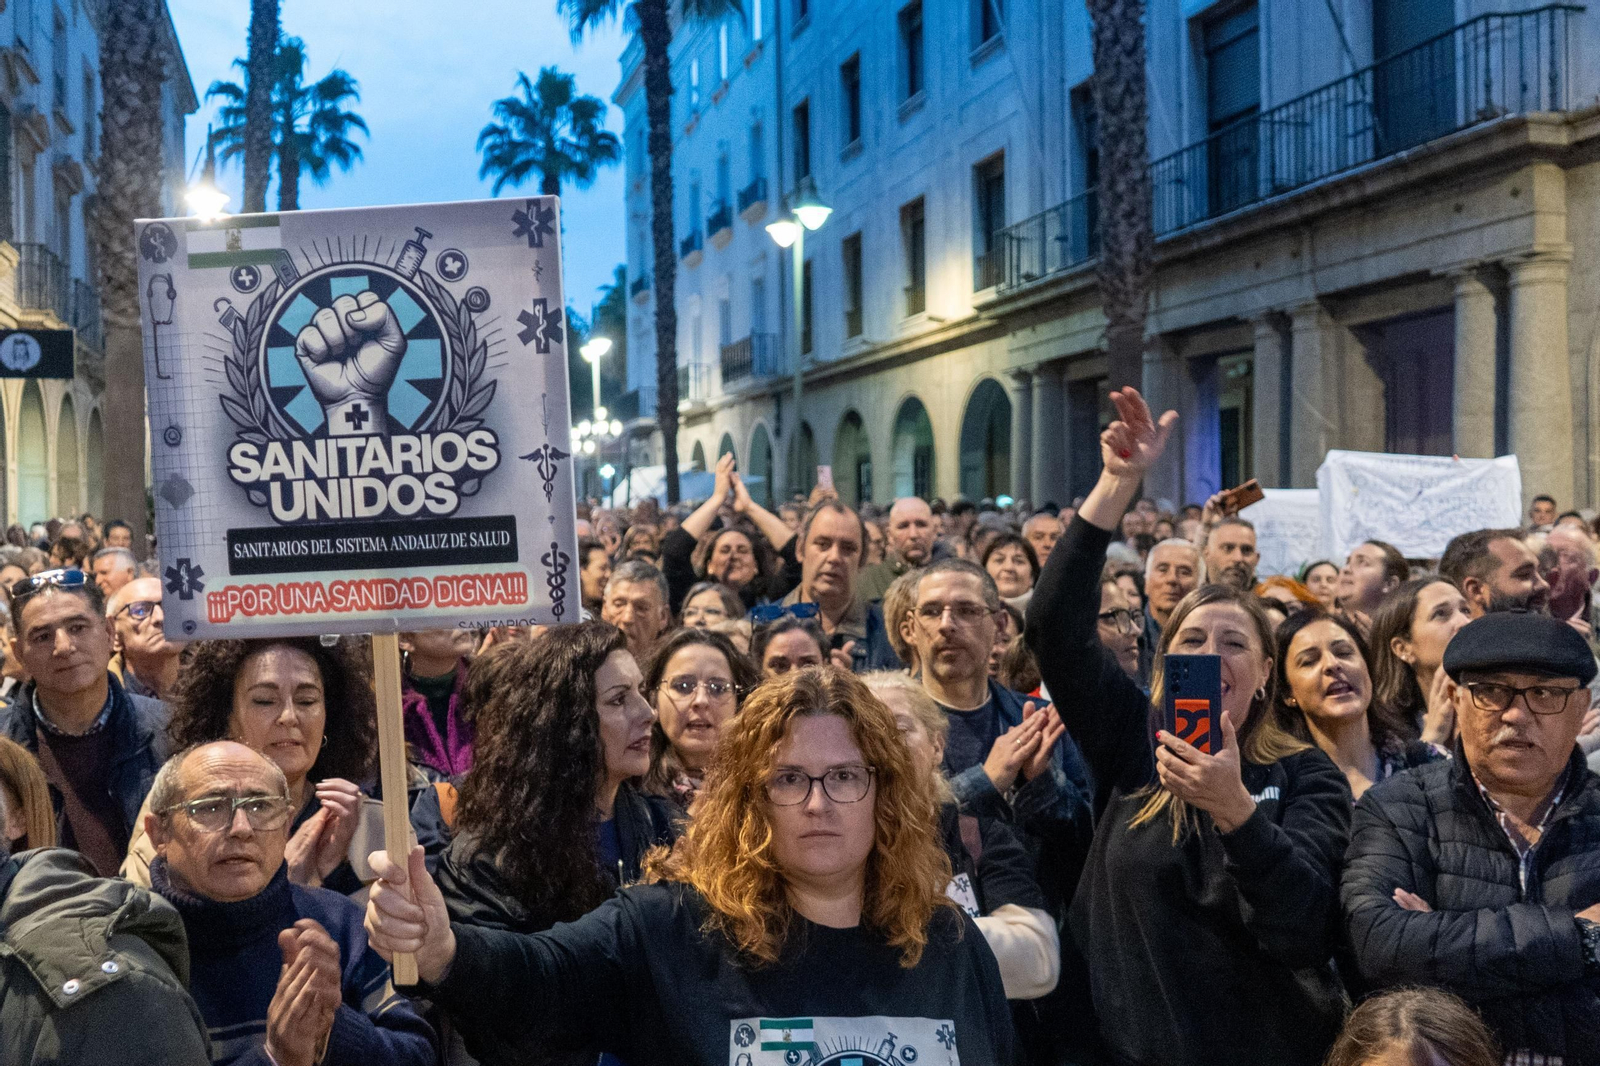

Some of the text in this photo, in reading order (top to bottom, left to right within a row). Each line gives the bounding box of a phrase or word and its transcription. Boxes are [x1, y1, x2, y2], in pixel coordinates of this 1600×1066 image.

[229, 430, 499, 483] SANITARIOS
[269, 472, 460, 522] UNIDOS
[234, 530, 511, 559] SANITARIOS DEL SISTEMA ANDALUZ DE SALUD
[209, 575, 526, 619] ¡¡¡POR UNA SANIDAD DIGNA!!!
